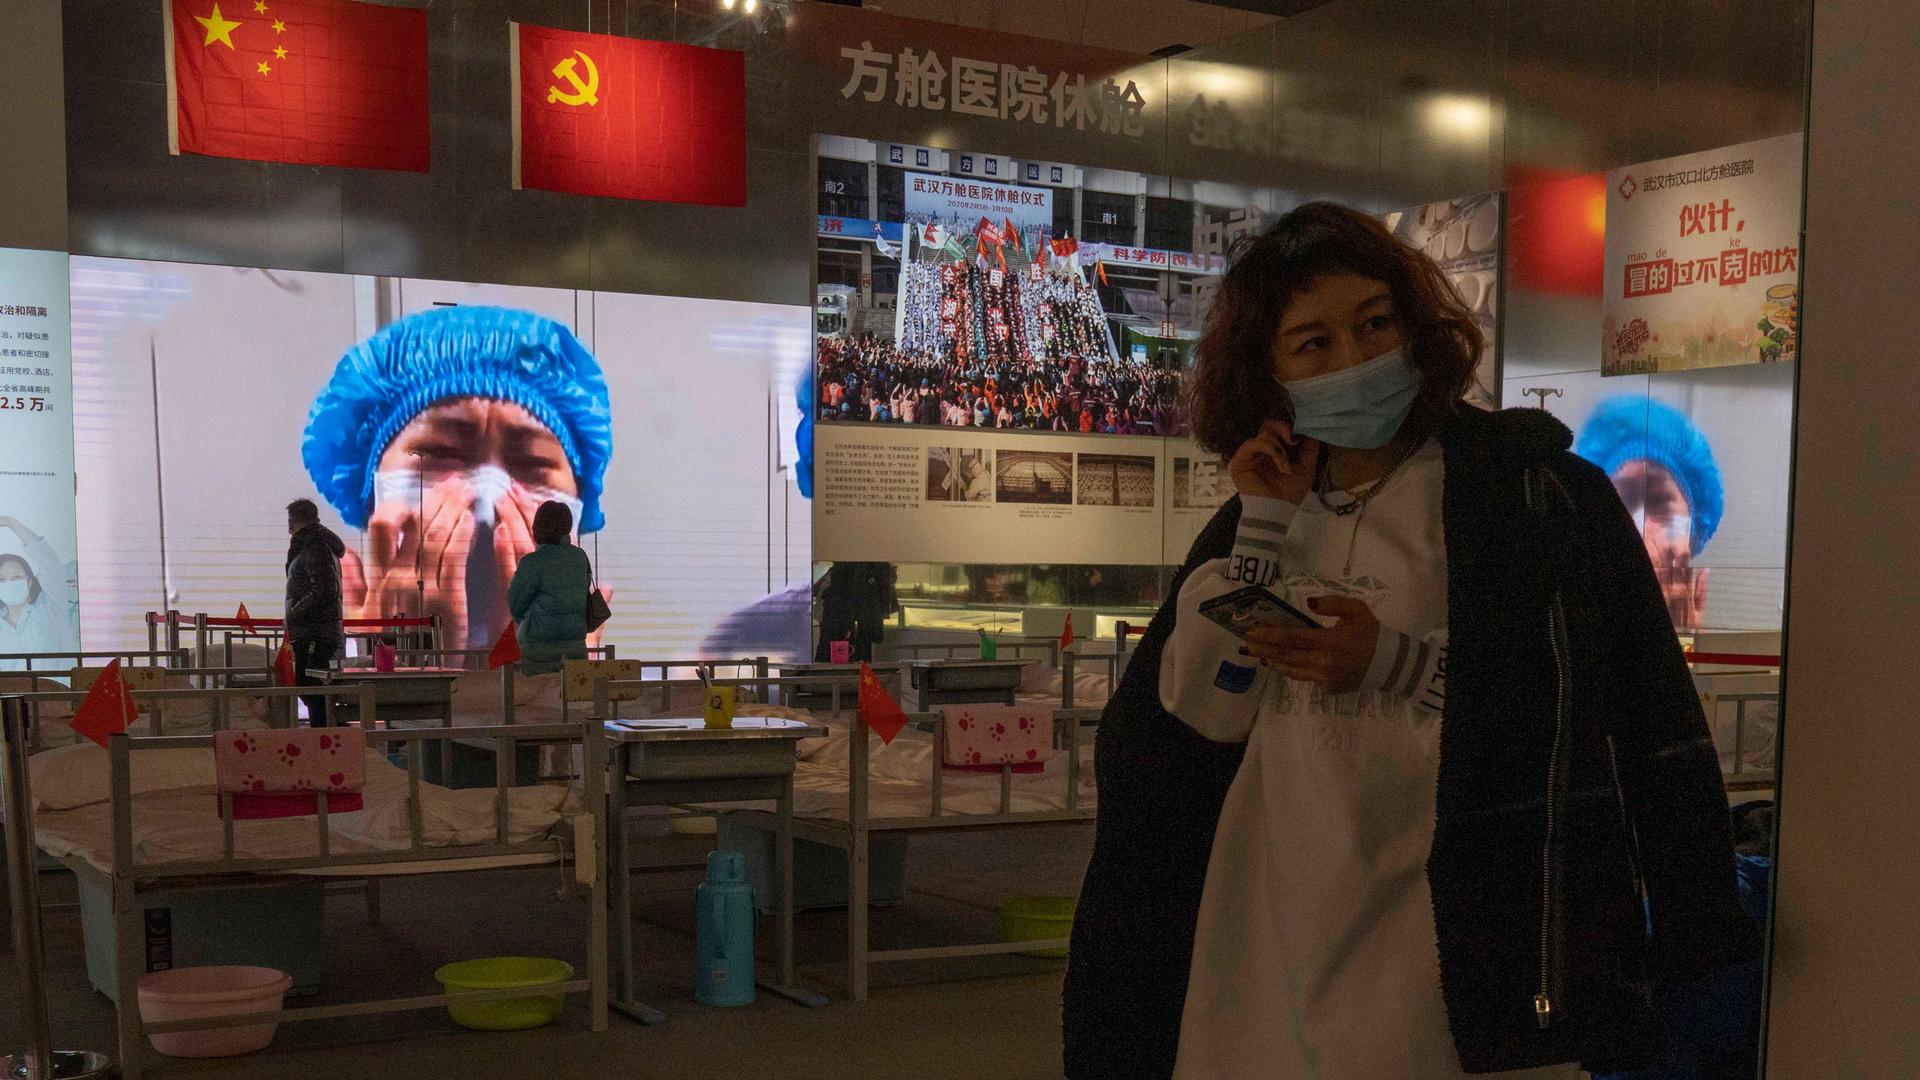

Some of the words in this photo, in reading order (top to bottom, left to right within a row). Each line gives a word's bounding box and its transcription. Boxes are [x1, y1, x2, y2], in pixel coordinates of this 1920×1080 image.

[841, 40, 1146, 136] 方舱医院休舱
[891, 147, 1062, 182] 武昌方舱医院
[1643, 159, 1754, 193] 武汉市汉口北方舱医院
[825, 180, 845, 195] 南2
[913, 178, 1045, 208] 武汉方舱医院休舱仪式
[947, 200, 1014, 214] 2020年2月5日-3月10日
[1102, 212, 1117, 225] 南1
[1655, 247, 1667, 259] de
[1729, 236, 1741, 248] ke
[0, 348, 50, 359] 患者和密切接
